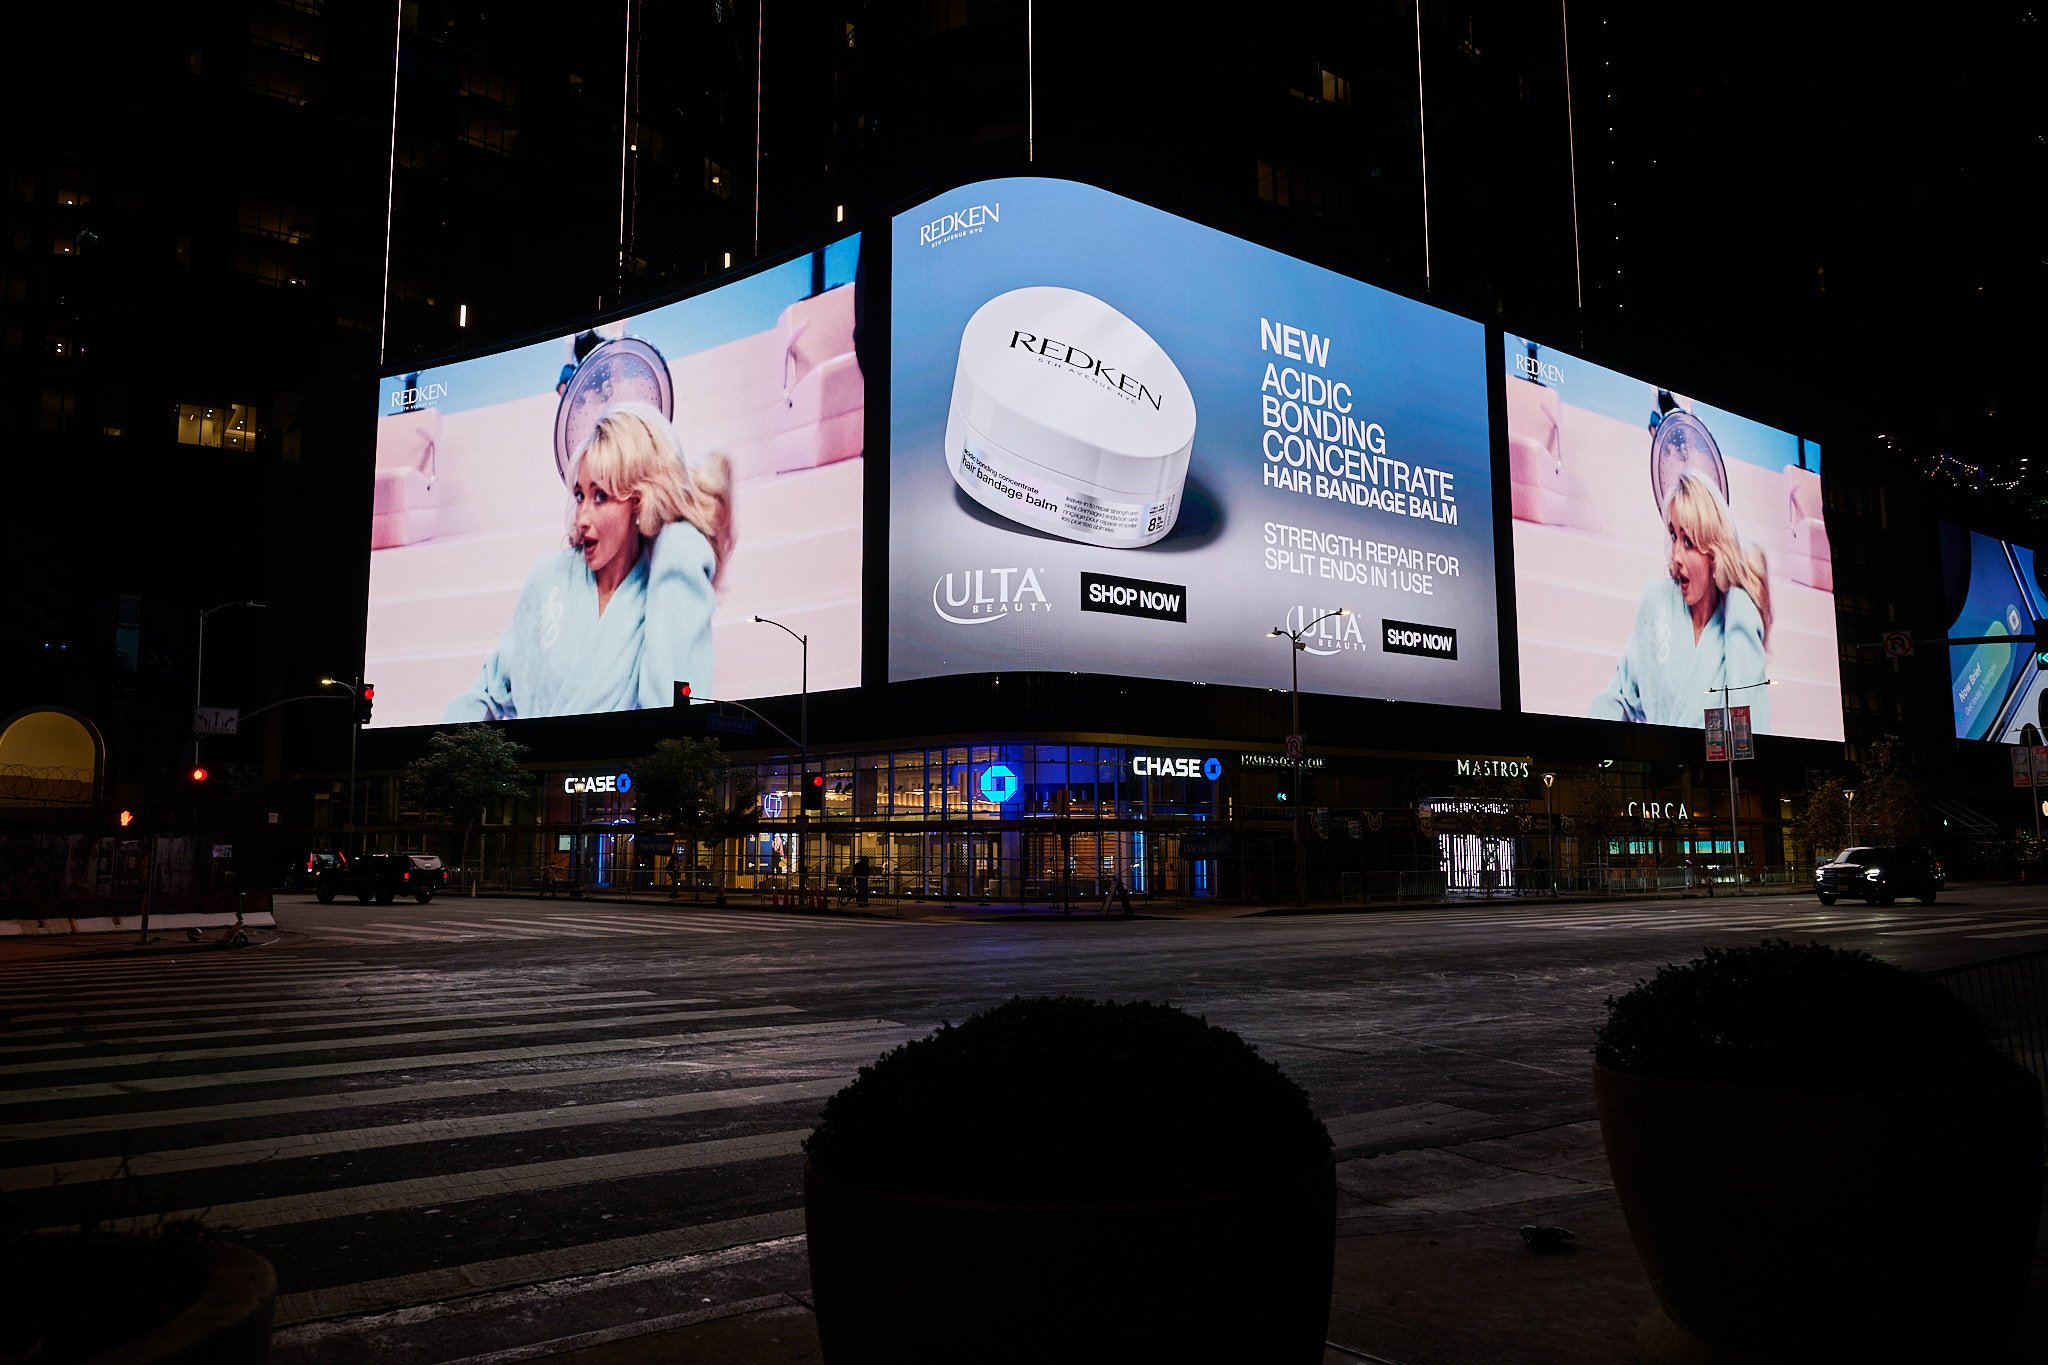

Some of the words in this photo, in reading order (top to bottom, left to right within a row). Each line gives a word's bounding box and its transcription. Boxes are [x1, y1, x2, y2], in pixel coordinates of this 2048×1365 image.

[920, 203, 1000, 246] REDKEN
[943, 231, 967, 243] AVENUE
[969, 227, 983, 235] NYC
[1260, 317, 1331, 368] NEW
[1009, 330, 1162, 411] REDKEN
[1069, 368, 1112, 391] AVENUE
[1117, 392, 1137, 406] NYC
[1260, 362, 1353, 414] ACIDIC
[1515, 353, 1565, 385] REDKEN
[391, 381, 448, 407] REDKEN
[1262, 394, 1386, 455] BONDING
[962, 454, 977, 474] hair
[976, 467, 1023, 500] bandage
[1025, 492, 1058, 513] balm
[976, 457, 998, 478] bonding
[998, 473, 1039, 495] concentrate
[1262, 429, 1455, 503] CONCENTRATE
[1263, 462, 1313, 495] HAIR
[1316, 474, 1407, 516] BANDAGE
[1409, 495, 1459, 526] BALM
[1264, 521, 1363, 560] STRENGTH
[1366, 540, 1424, 571] REPAIR
[1426, 552, 1460, 578] FOR
[945, 567, 1047, 607] ULTA
[1264, 547, 1316, 576] SPLIT
[1319, 557, 1368, 585] ENDS
[1370, 566, 1388, 588] IN
[1390, 569, 1399, 590] 1
[1400, 571, 1434, 596] USE
[972, 602, 1053, 614] BEAUTY
[1088, 583, 1138, 606] SHOP
[1139, 589, 1181, 613] NOW
[1318, 638, 1368, 652] BEAUTY
[1387, 628, 1422, 649] SHOP
[1422, 635, 1453, 652] NOW
[1958, 681, 1972, 703] Now
[1969, 662, 1982, 686] Brief
[564, 775, 617, 794] CASE
[1132, 756, 1202, 778] CHASE
[1457, 758, 1530, 778] MASTRO'S
[1627, 801, 1689, 820] CIRCA
